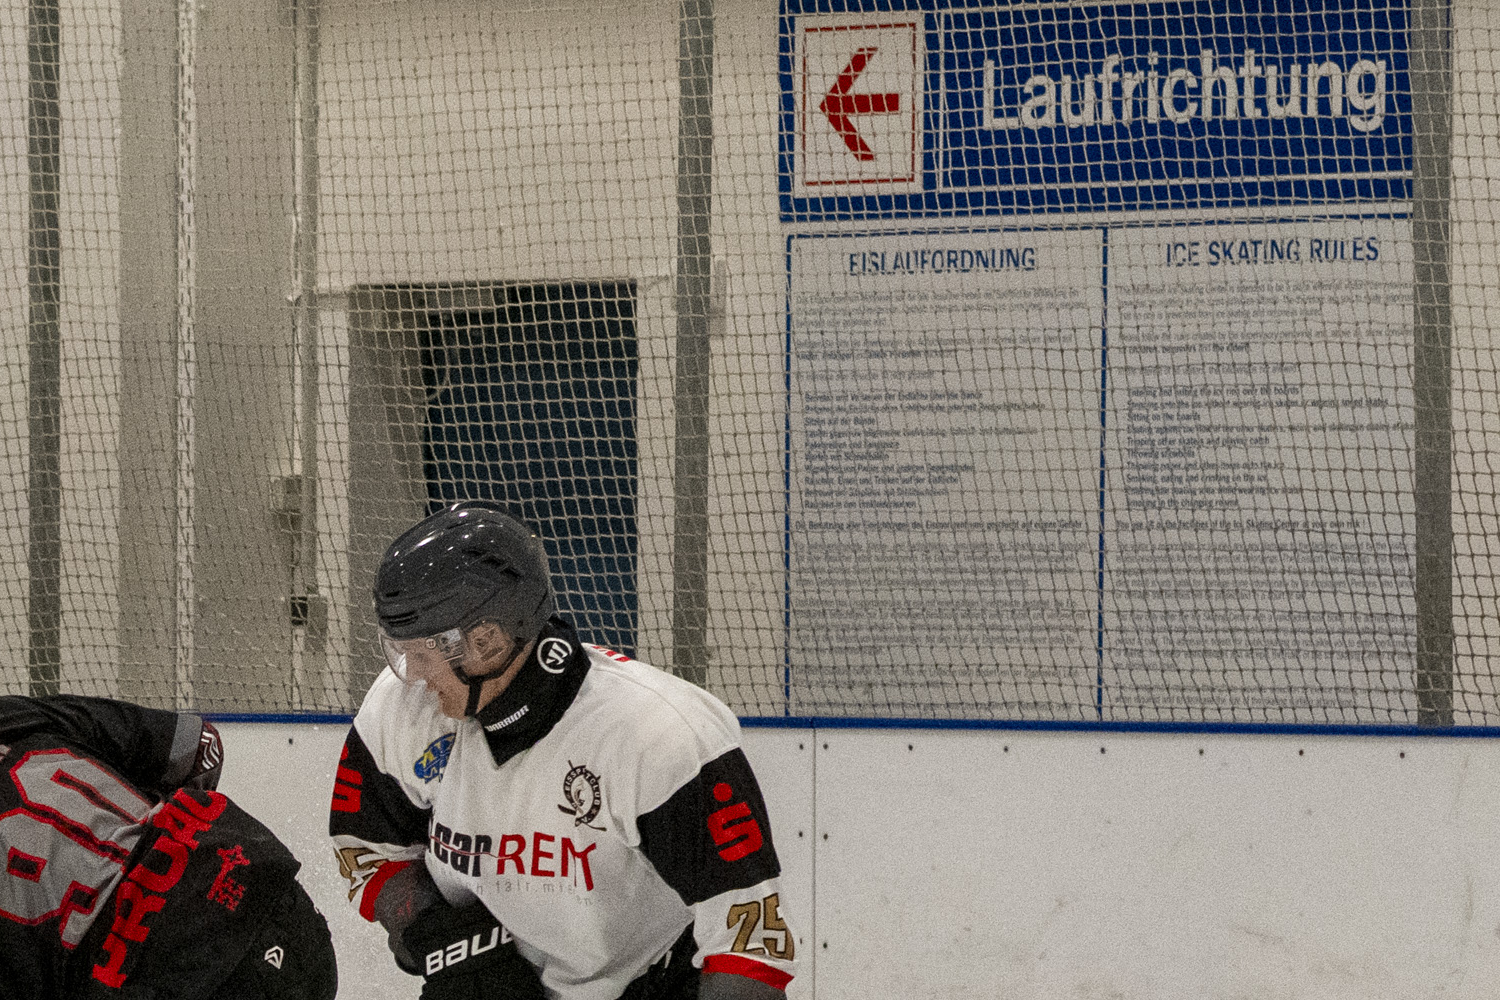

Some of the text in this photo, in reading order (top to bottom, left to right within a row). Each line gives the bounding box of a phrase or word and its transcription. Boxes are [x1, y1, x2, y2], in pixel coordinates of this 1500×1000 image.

[981, 48, 1387, 130] Laufrichtung
[849, 247, 1037, 276] EISLAUFORDNUNG
[1167, 237, 1379, 267] ICE SKATING RULES
[484, 705, 529, 732] WARRIOR
[726, 892, 795, 962] 25
